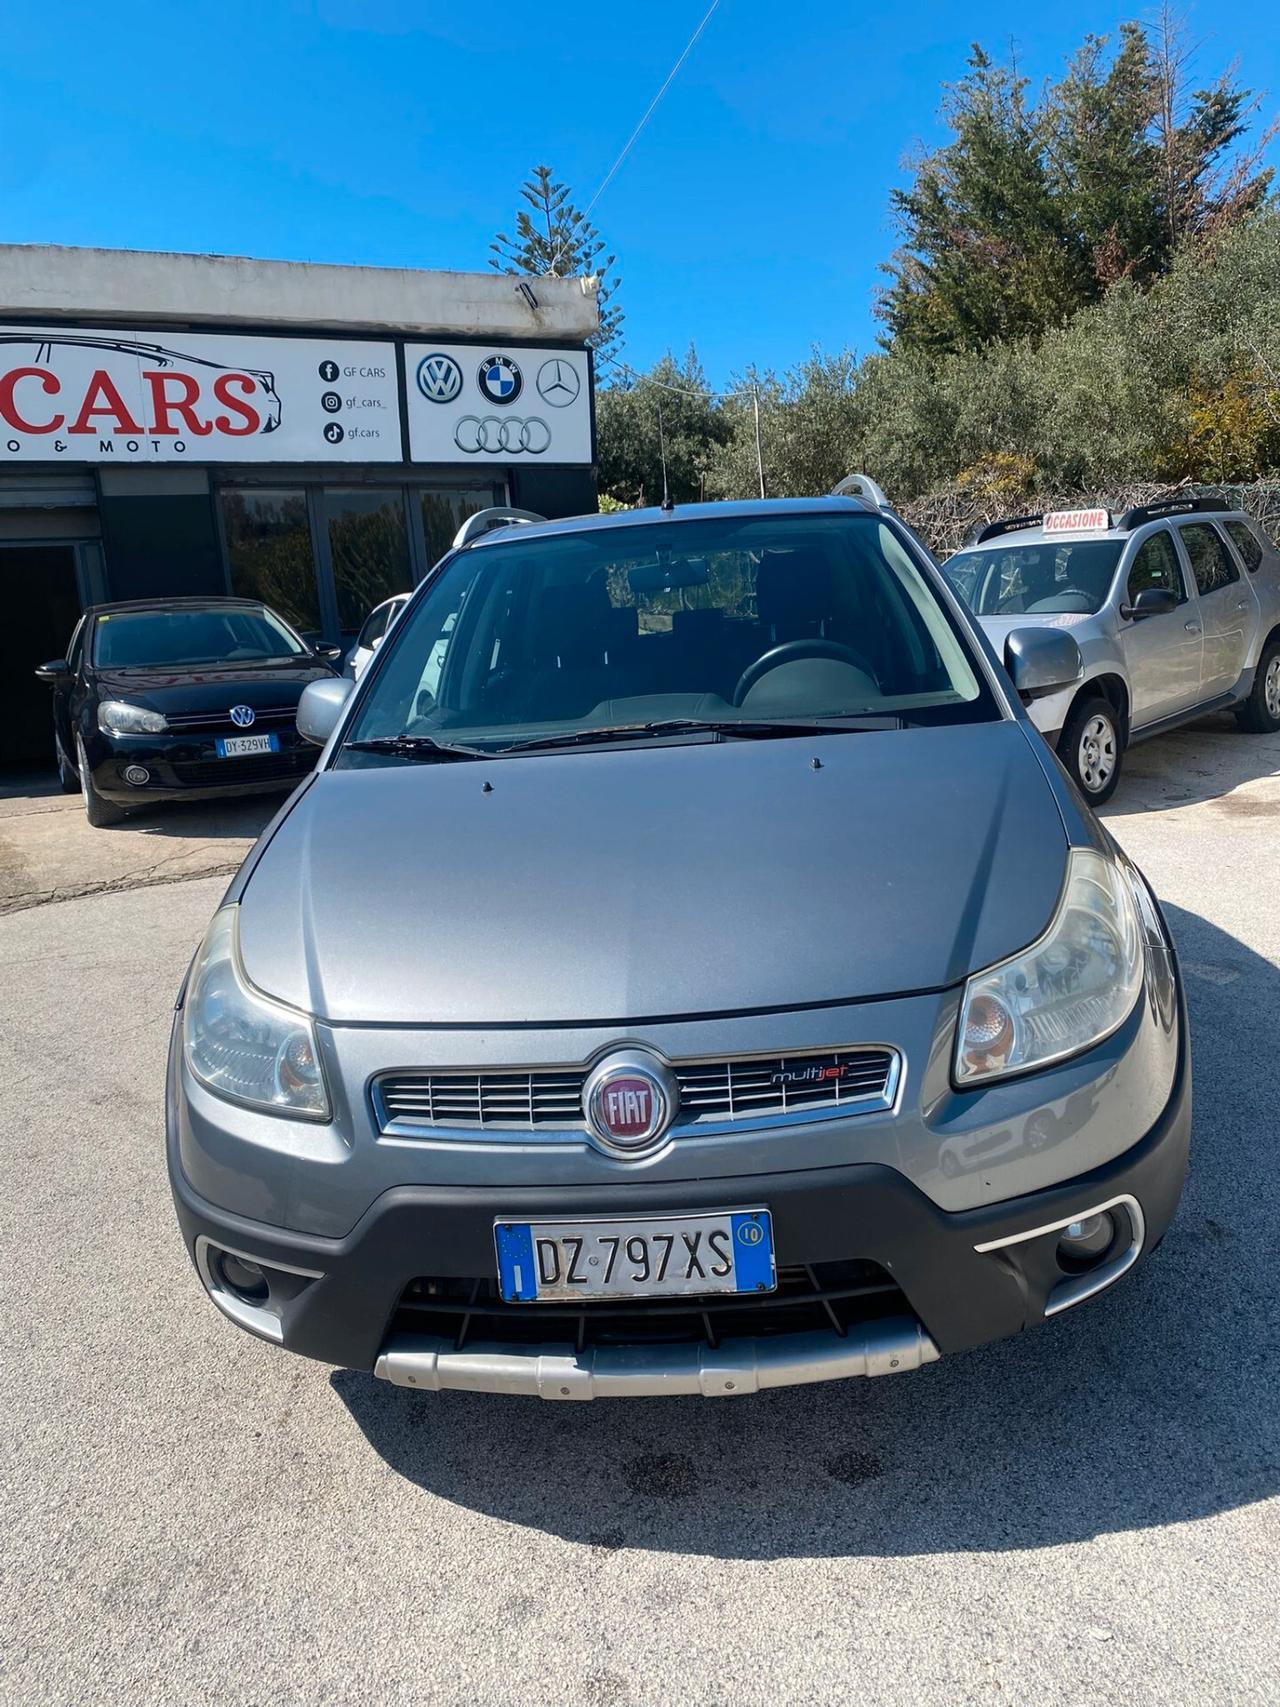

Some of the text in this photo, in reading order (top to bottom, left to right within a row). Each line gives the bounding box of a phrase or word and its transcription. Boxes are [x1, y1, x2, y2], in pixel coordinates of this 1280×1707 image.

[343, 366, 386, 378] GF CARS
[482, 357, 518, 374] BMW
[0, 367, 260, 437] CARS
[348, 427, 380, 440] gf.cars
[54, 441, 68, 452] &
[100, 440, 187, 453] MOTO
[1046, 511, 1104, 529] OCCASIONE
[771, 1064, 849, 1083] multijet
[607, 1089, 649, 1126] FIAT
[744, 1227, 759, 1242] 10
